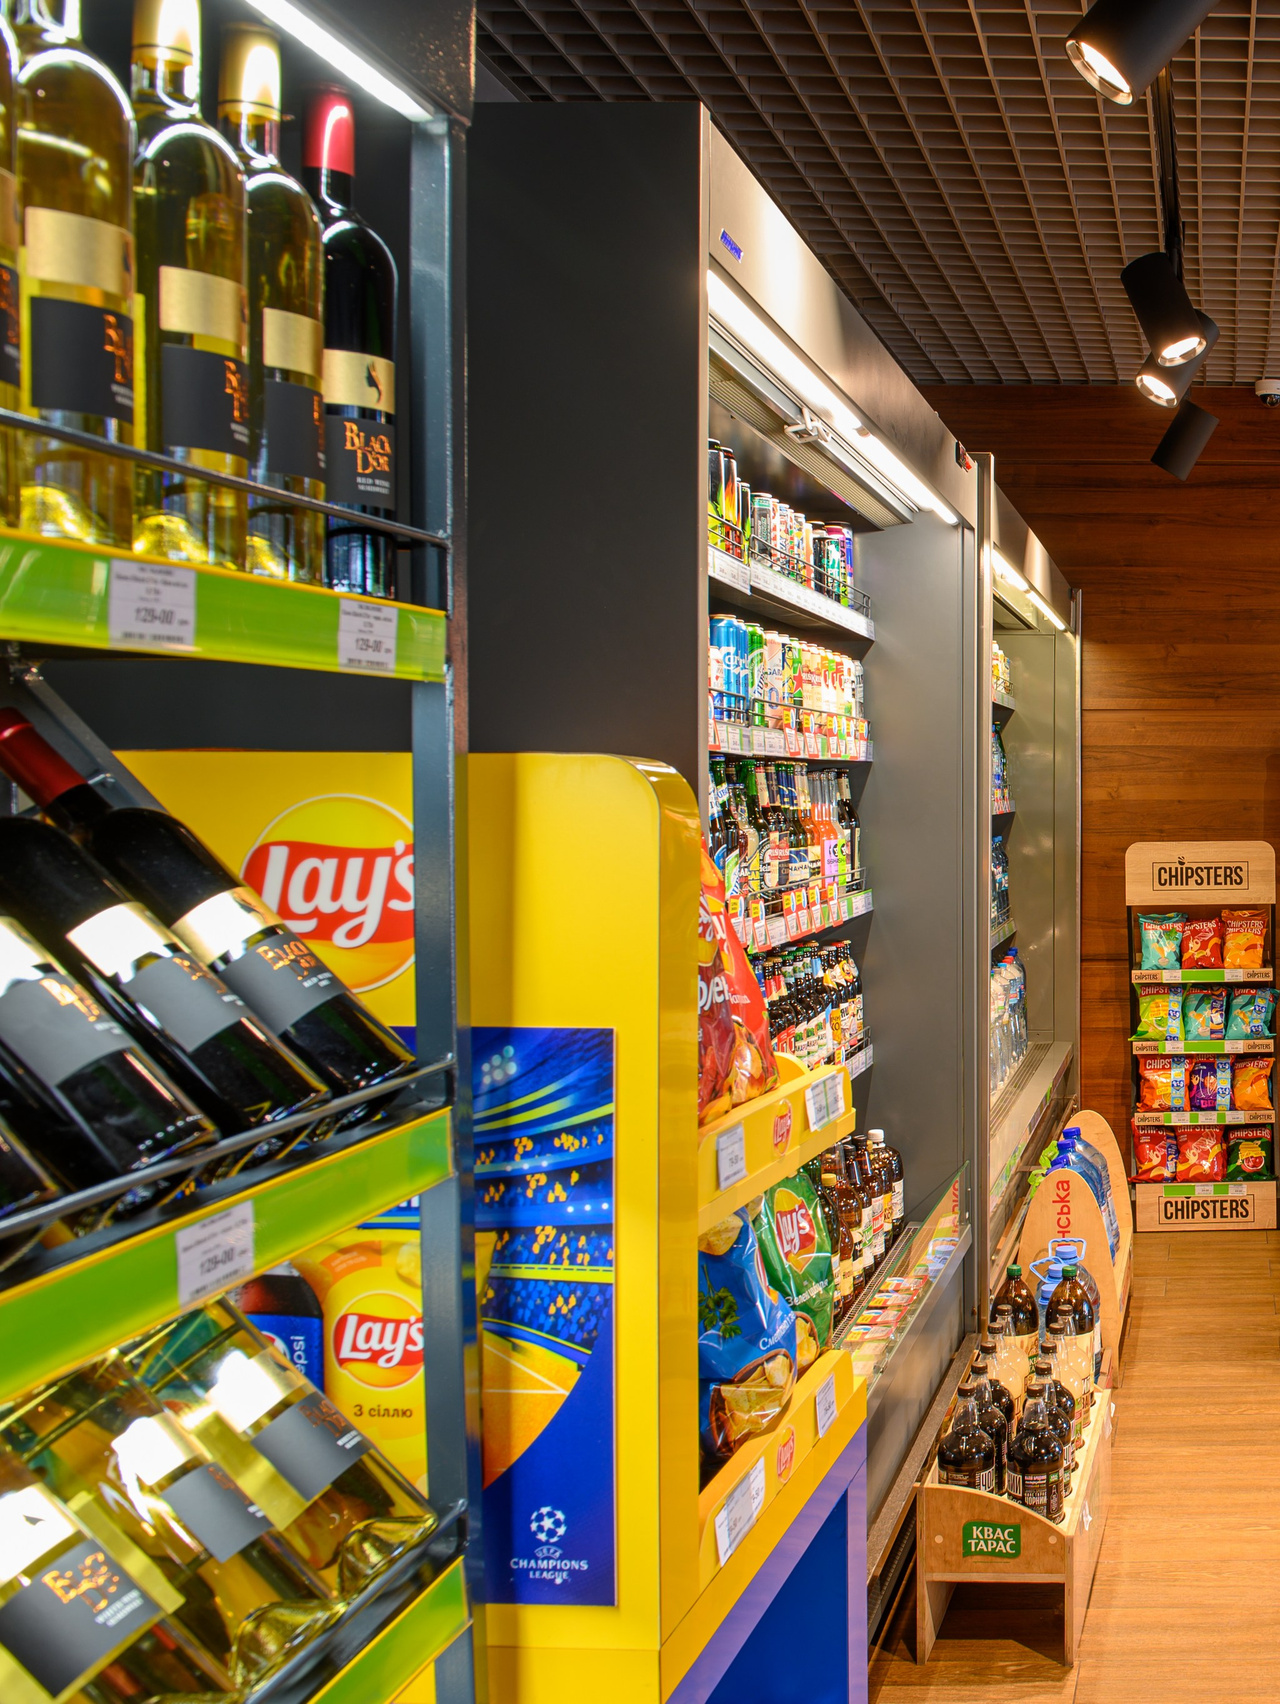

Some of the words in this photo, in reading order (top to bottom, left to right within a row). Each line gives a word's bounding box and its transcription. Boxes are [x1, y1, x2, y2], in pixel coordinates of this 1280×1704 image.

[1052, 1179, 1071, 1240] нська
[368, 1404, 413, 1419] сіллю
[971, 1526, 1014, 1541] КВАС
[967, 1539, 1016, 1554] ТАРАС
[509, 1557, 589, 1571] CHAMPIONS
[529, 1570, 569, 1580] LEAGUE
